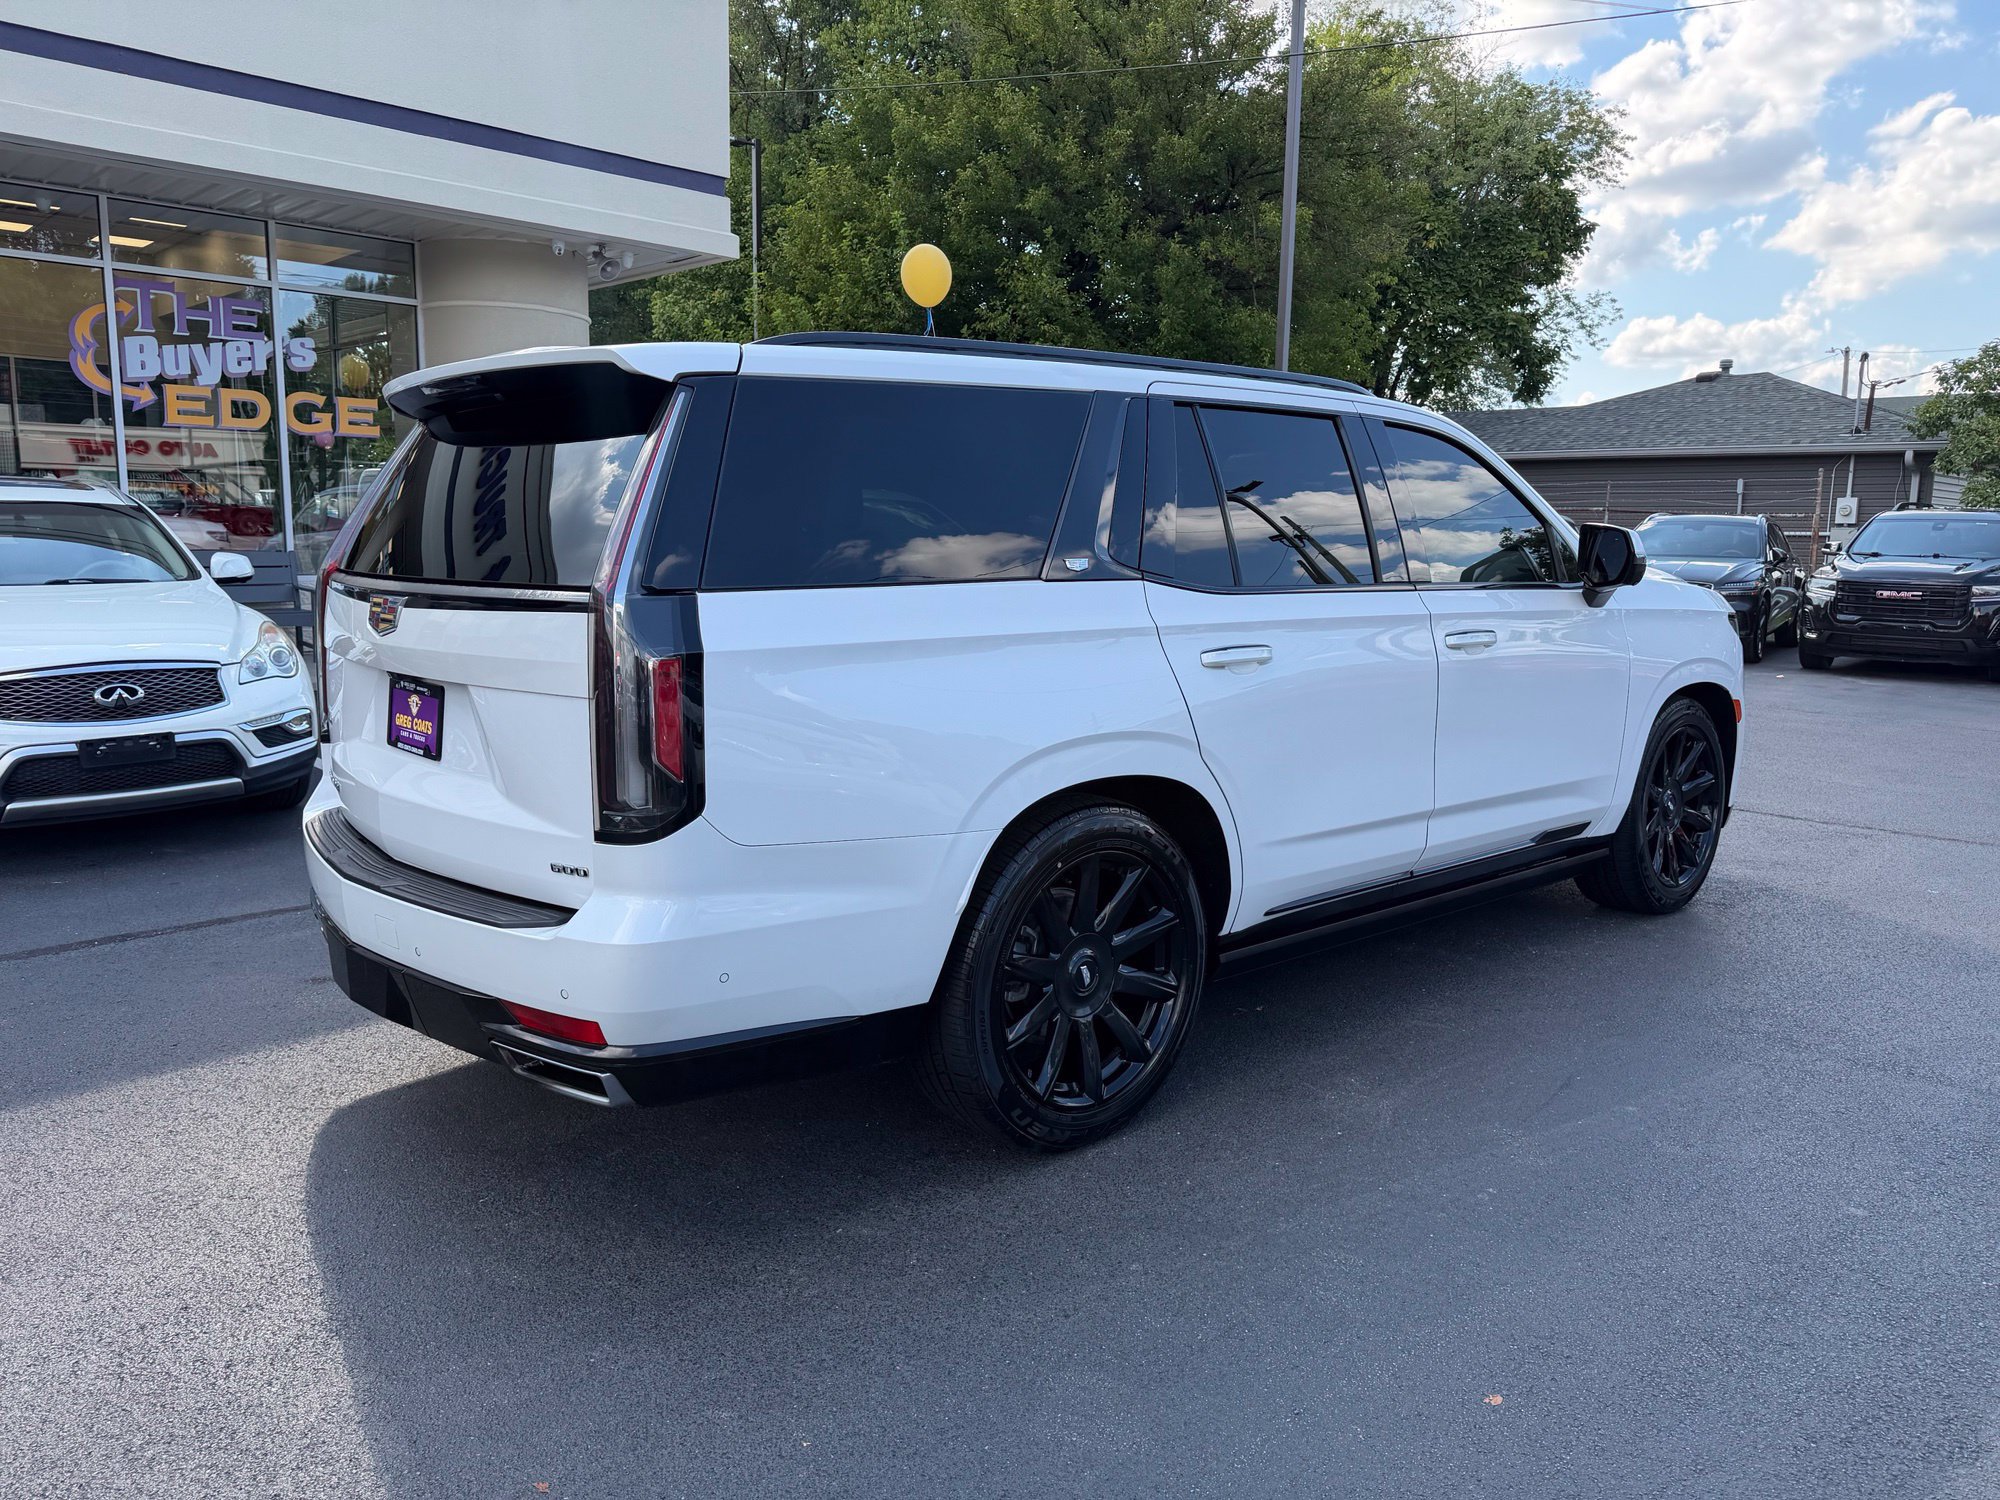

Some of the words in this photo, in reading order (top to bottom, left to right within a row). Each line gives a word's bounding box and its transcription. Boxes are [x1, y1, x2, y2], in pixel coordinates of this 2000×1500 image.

[113, 276, 266, 342] THE
[162, 383, 381, 439] EDGE
[1876, 590, 1922, 600] GMC
[395, 713, 412, 728] GREG
[413, 718, 432, 734] COATS
